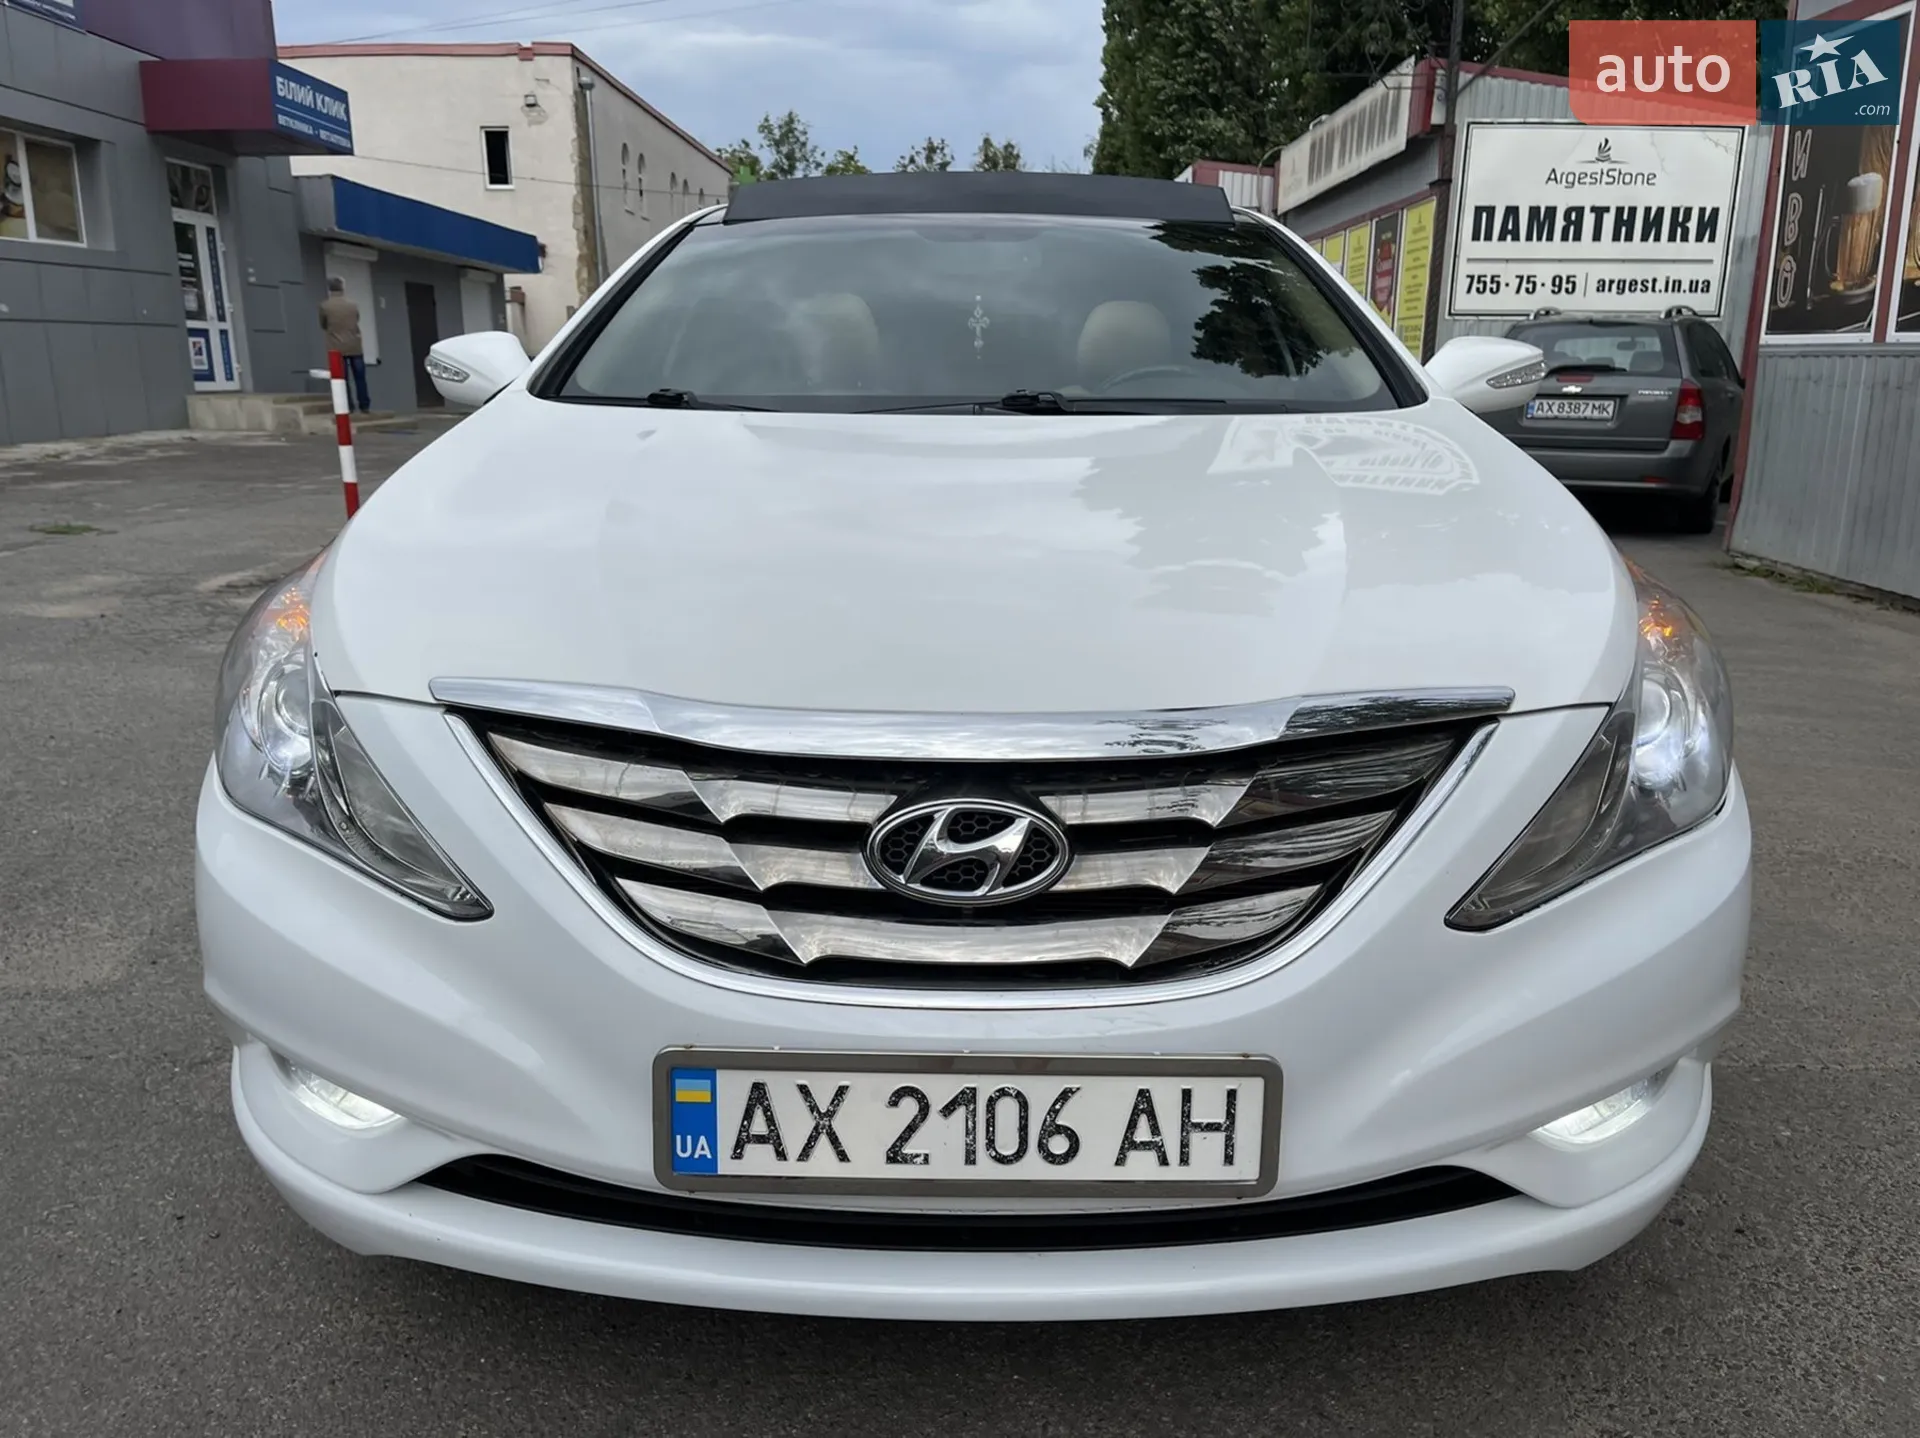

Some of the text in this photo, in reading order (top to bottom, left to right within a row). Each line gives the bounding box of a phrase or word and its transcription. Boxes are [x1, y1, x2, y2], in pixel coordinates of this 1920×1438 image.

[275, 75, 348, 122] БІЛИЙ КЛИК
[1545, 167, 1657, 189] ArgestStone
[1471, 205, 1720, 243] ПАМЯТНИКИ
[1596, 275, 1711, 295] argest.in.ua
[1535, 401, 1612, 416] AX 8387 MK
[730, 1081, 1239, 1166] AX 2106 AH
[675, 1134, 713, 1160] UA
